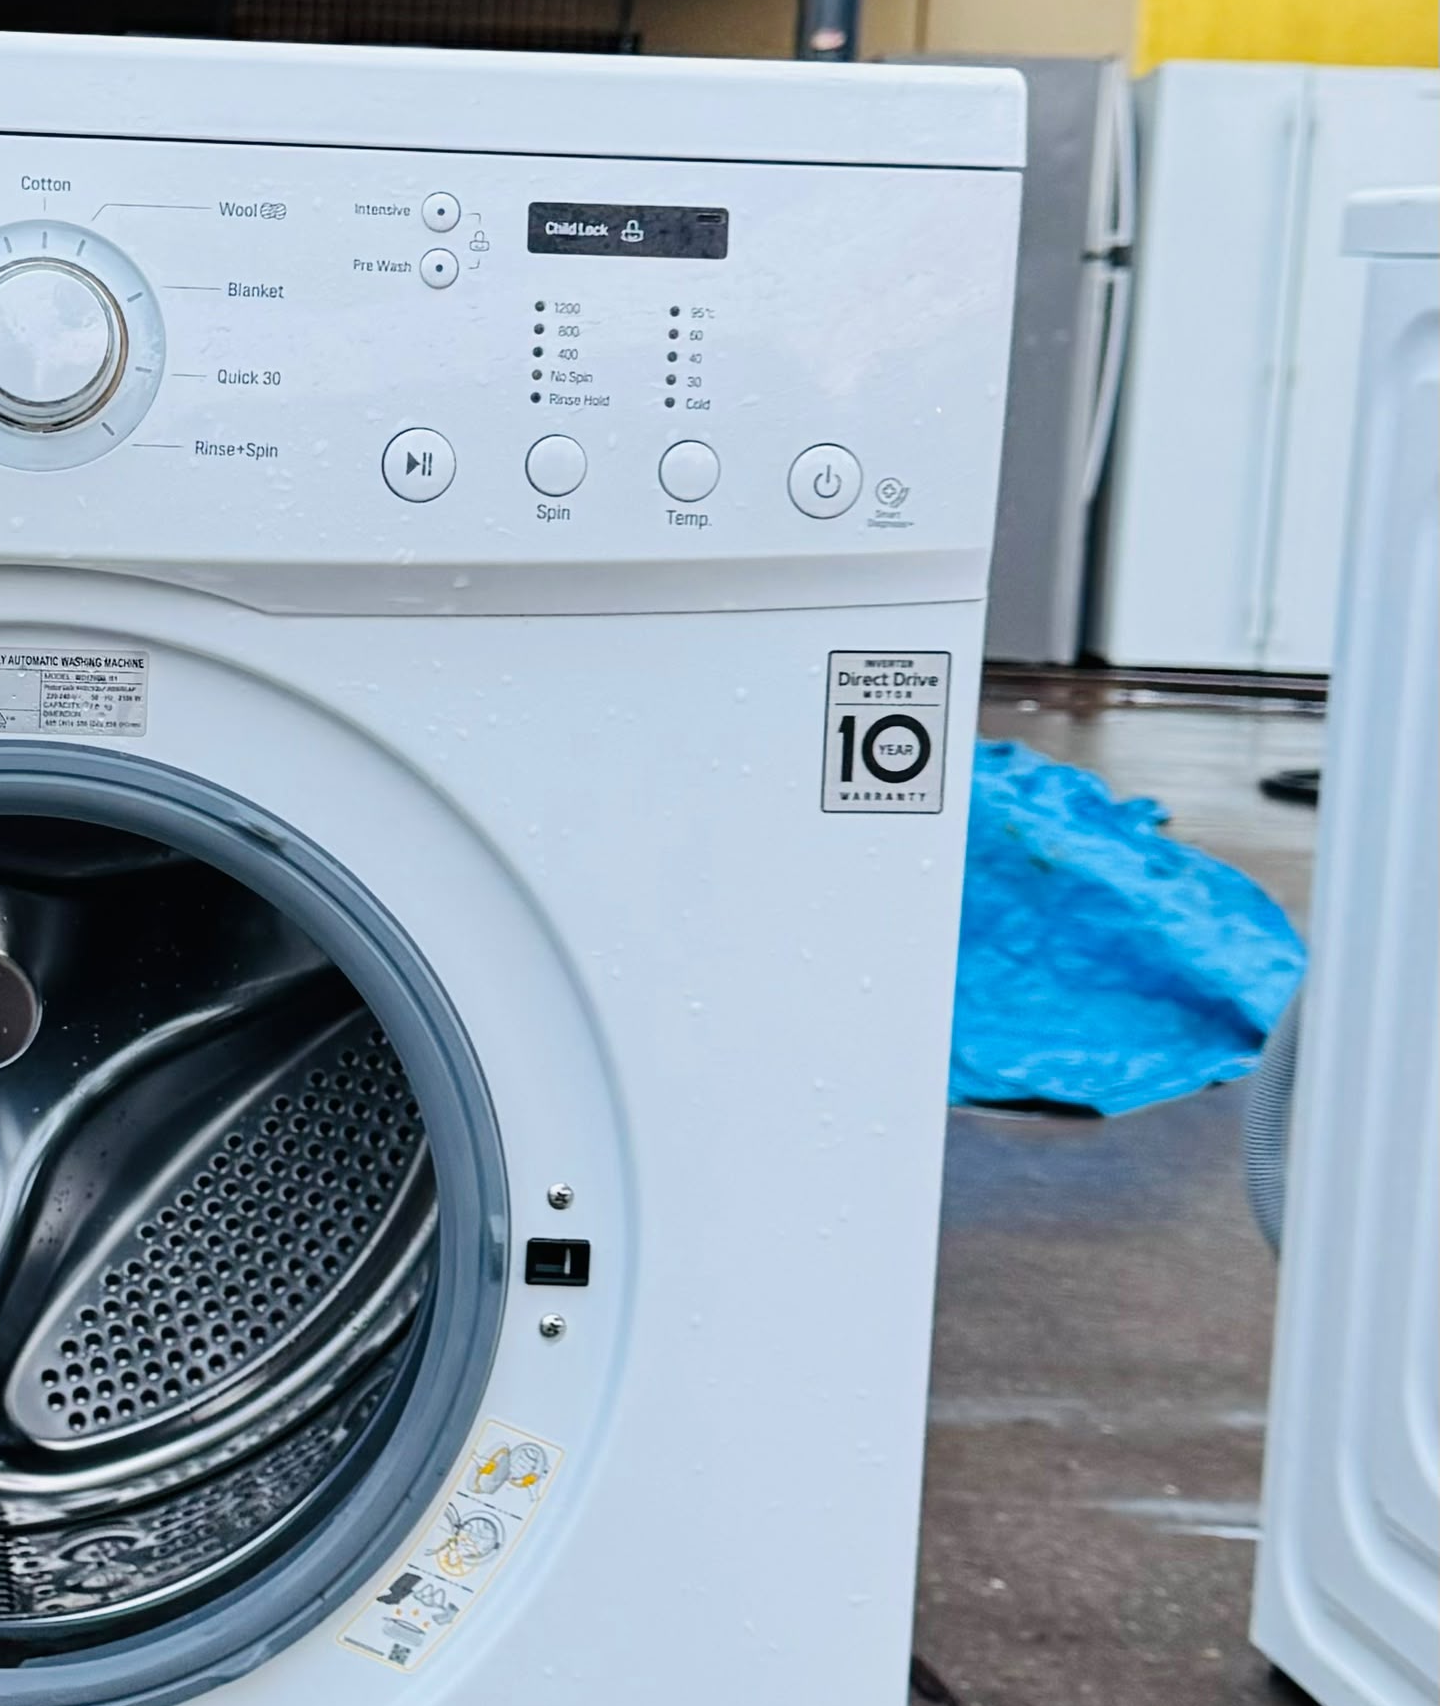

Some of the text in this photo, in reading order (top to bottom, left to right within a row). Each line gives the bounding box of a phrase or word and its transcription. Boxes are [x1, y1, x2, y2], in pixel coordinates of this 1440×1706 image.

[21, 176, 71, 192] Cotton
[218, 201, 258, 218] Wool
[354, 203, 411, 217] Intensive
[545, 221, 609, 237] Child Lock
[353, 258, 412, 273] Pre Wash
[227, 281, 284, 299] Blanket
[554, 302, 581, 315] 1200
[558, 348, 579, 361] 400
[689, 353, 703, 364] 40
[217, 368, 281, 386] Quick 30
[550, 370, 594, 385] No Spin
[686, 376, 702, 388] 30
[549, 393, 610, 407] Rinse Hold
[686, 398, 711, 410] Cold
[195, 440, 279, 461] Rinse+Spin
[536, 503, 571, 524] Spin
[666, 510, 713, 529] Temp.
[8, 654, 59, 667] AUTOMATIC
[61, 656, 103, 668] WASHING
[104, 658, 145, 669] MACHINE
[864, 660, 914, 668] INVERTER
[838, 672, 939, 687] Direct Drive
[863, 690, 912, 699] MOTOR
[838, 713, 931, 784] 10
[878, 744, 913, 756] YEAR
[839, 792, 926, 802] WARRANTY
